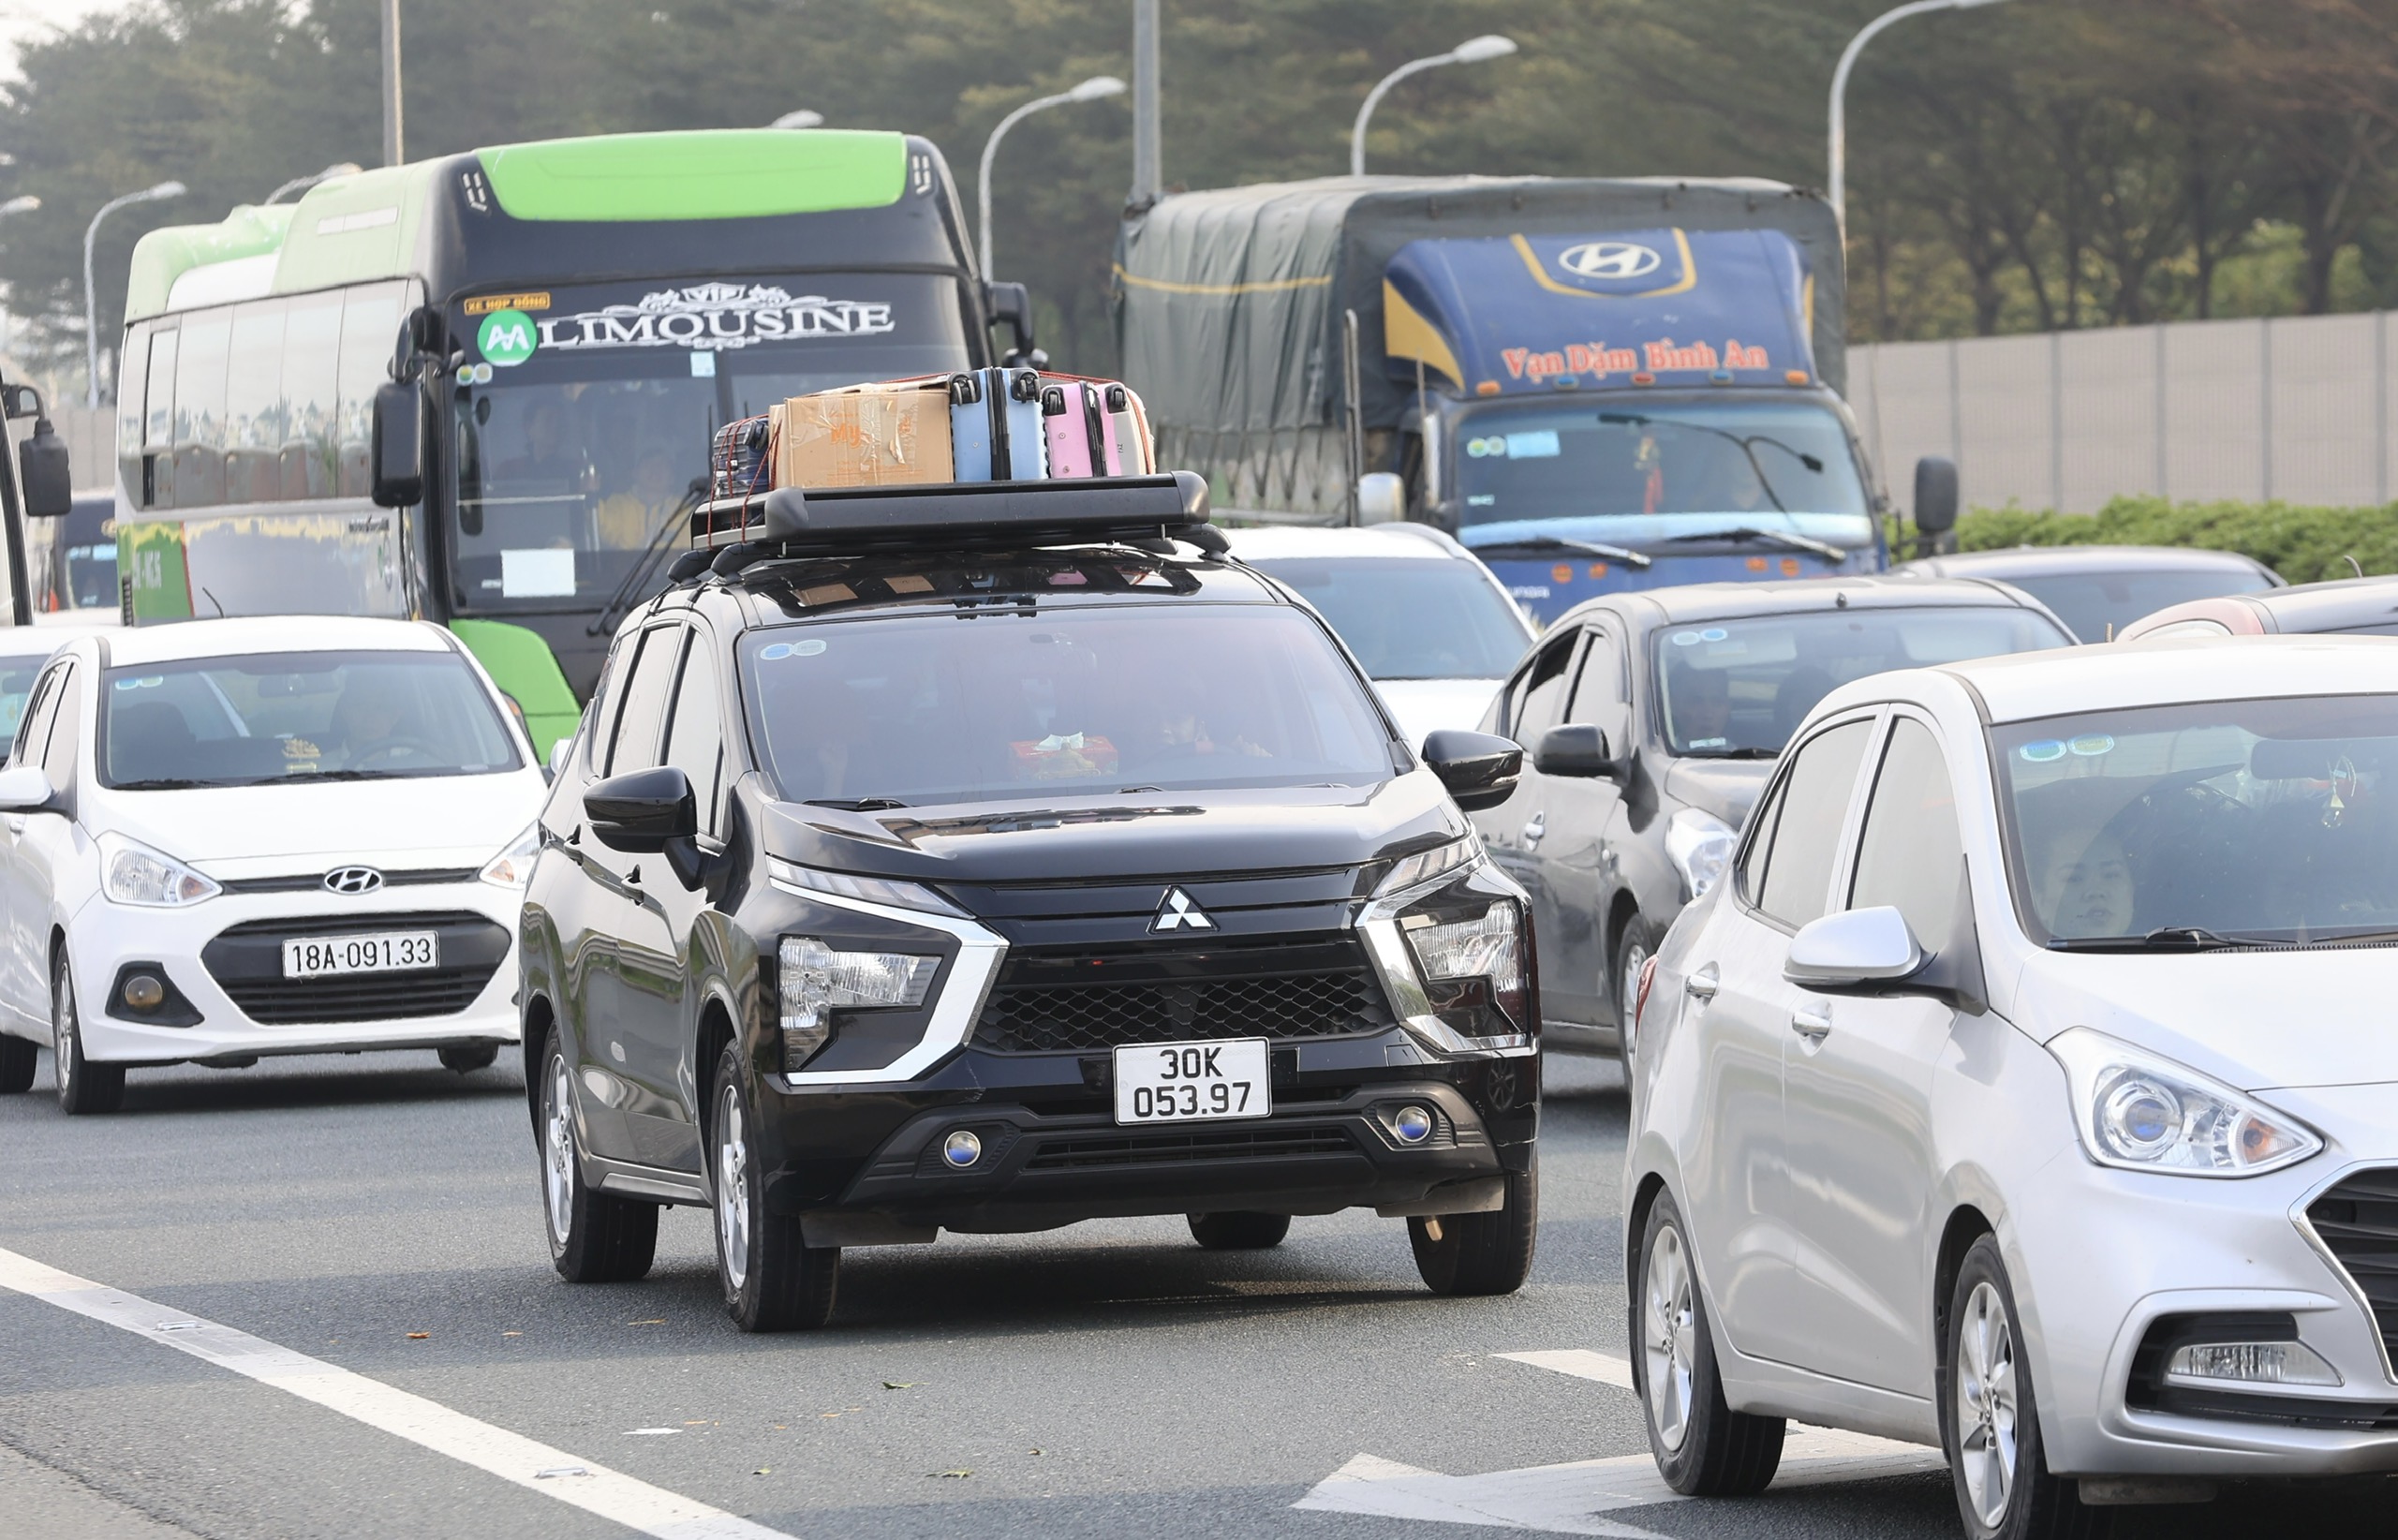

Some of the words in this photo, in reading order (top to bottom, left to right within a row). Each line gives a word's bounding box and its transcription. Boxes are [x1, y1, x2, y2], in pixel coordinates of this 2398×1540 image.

[536, 304, 896, 349] LIMOUSINE
[1502, 348, 1564, 384] Vạn
[1565, 341, 1637, 380] Dặm
[1724, 339, 1769, 370] An
[292, 939, 431, 972] 18A-091.33
[1160, 1046, 1223, 1080] 30K
[1133, 1081, 1251, 1118] 053.97
